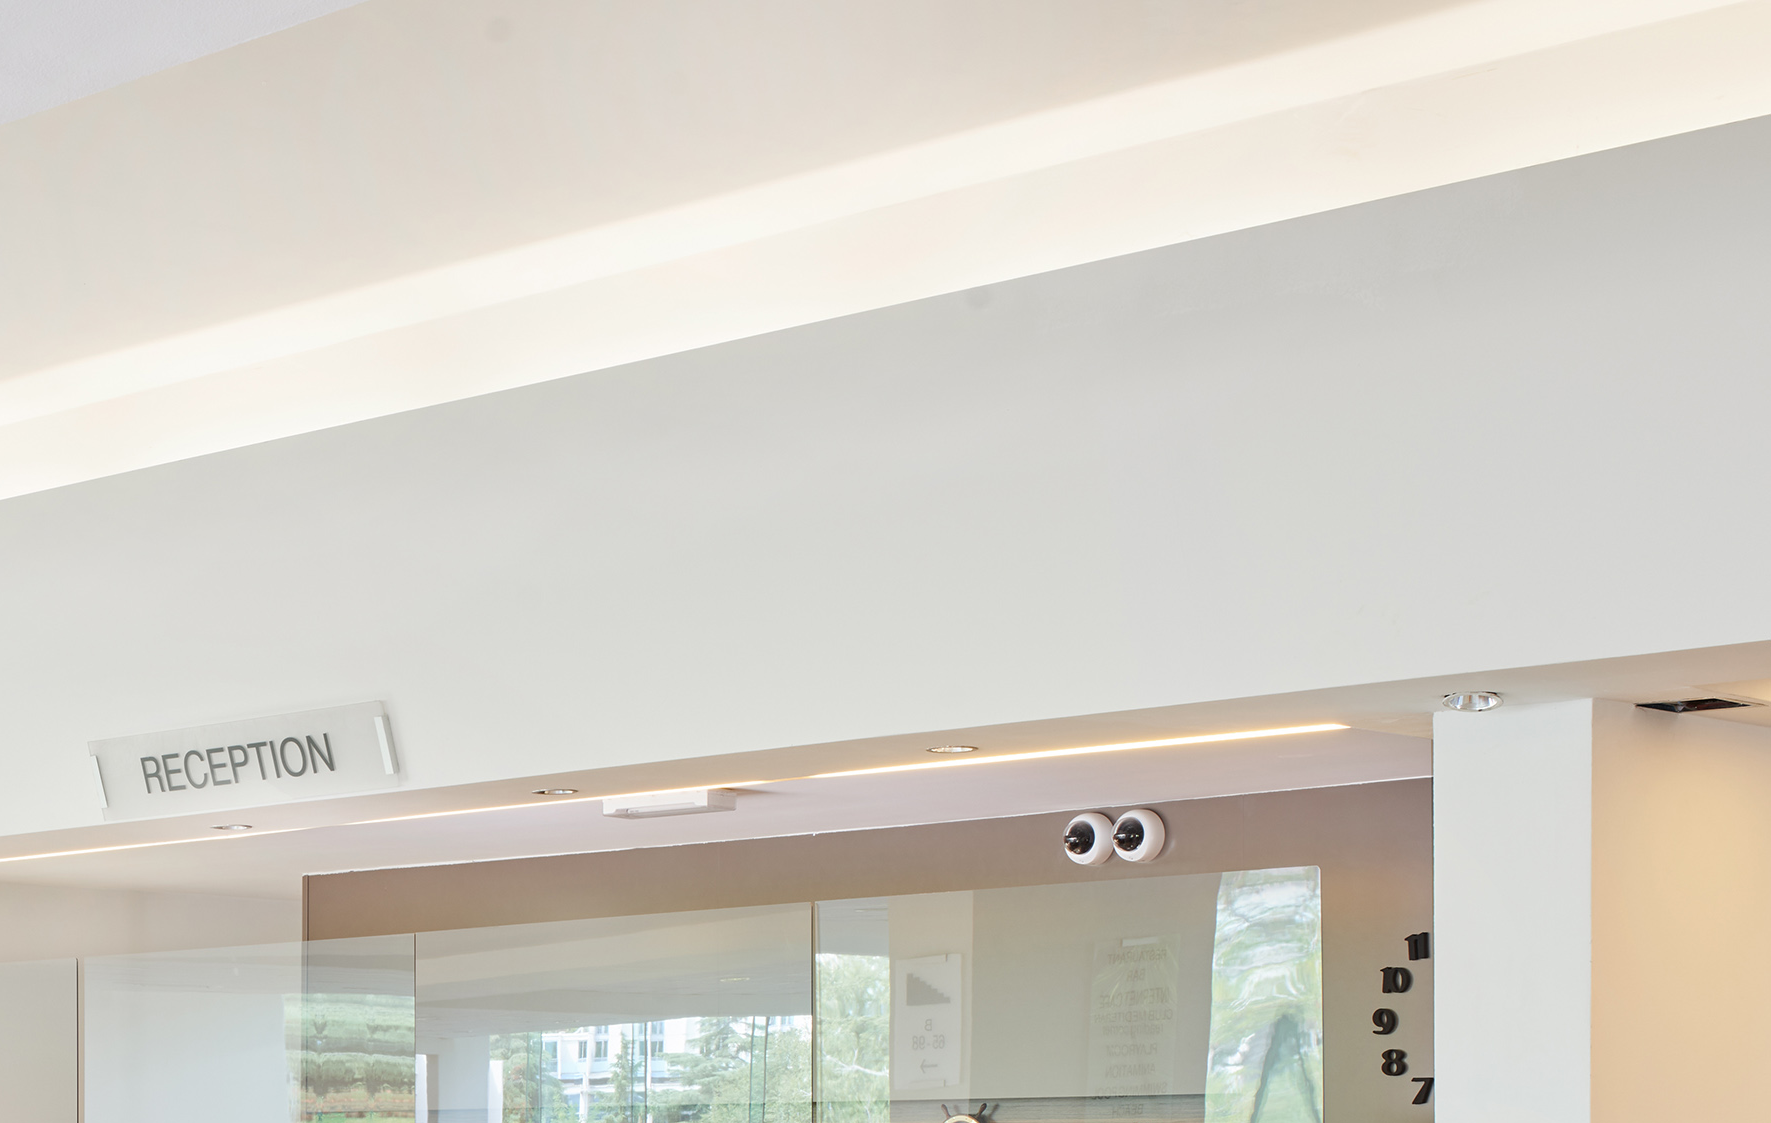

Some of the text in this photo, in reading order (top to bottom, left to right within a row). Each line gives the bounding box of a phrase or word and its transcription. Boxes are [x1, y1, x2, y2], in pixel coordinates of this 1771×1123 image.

[139, 732, 336, 794] RECEPTION
[1404, 932, 1430, 961] 11
[1380, 966, 1412, 994] 10
[1372, 1008, 1398, 1035] 9
[1381, 1048, 1408, 1076] 8
[1411, 1077, 1435, 1105] 7
